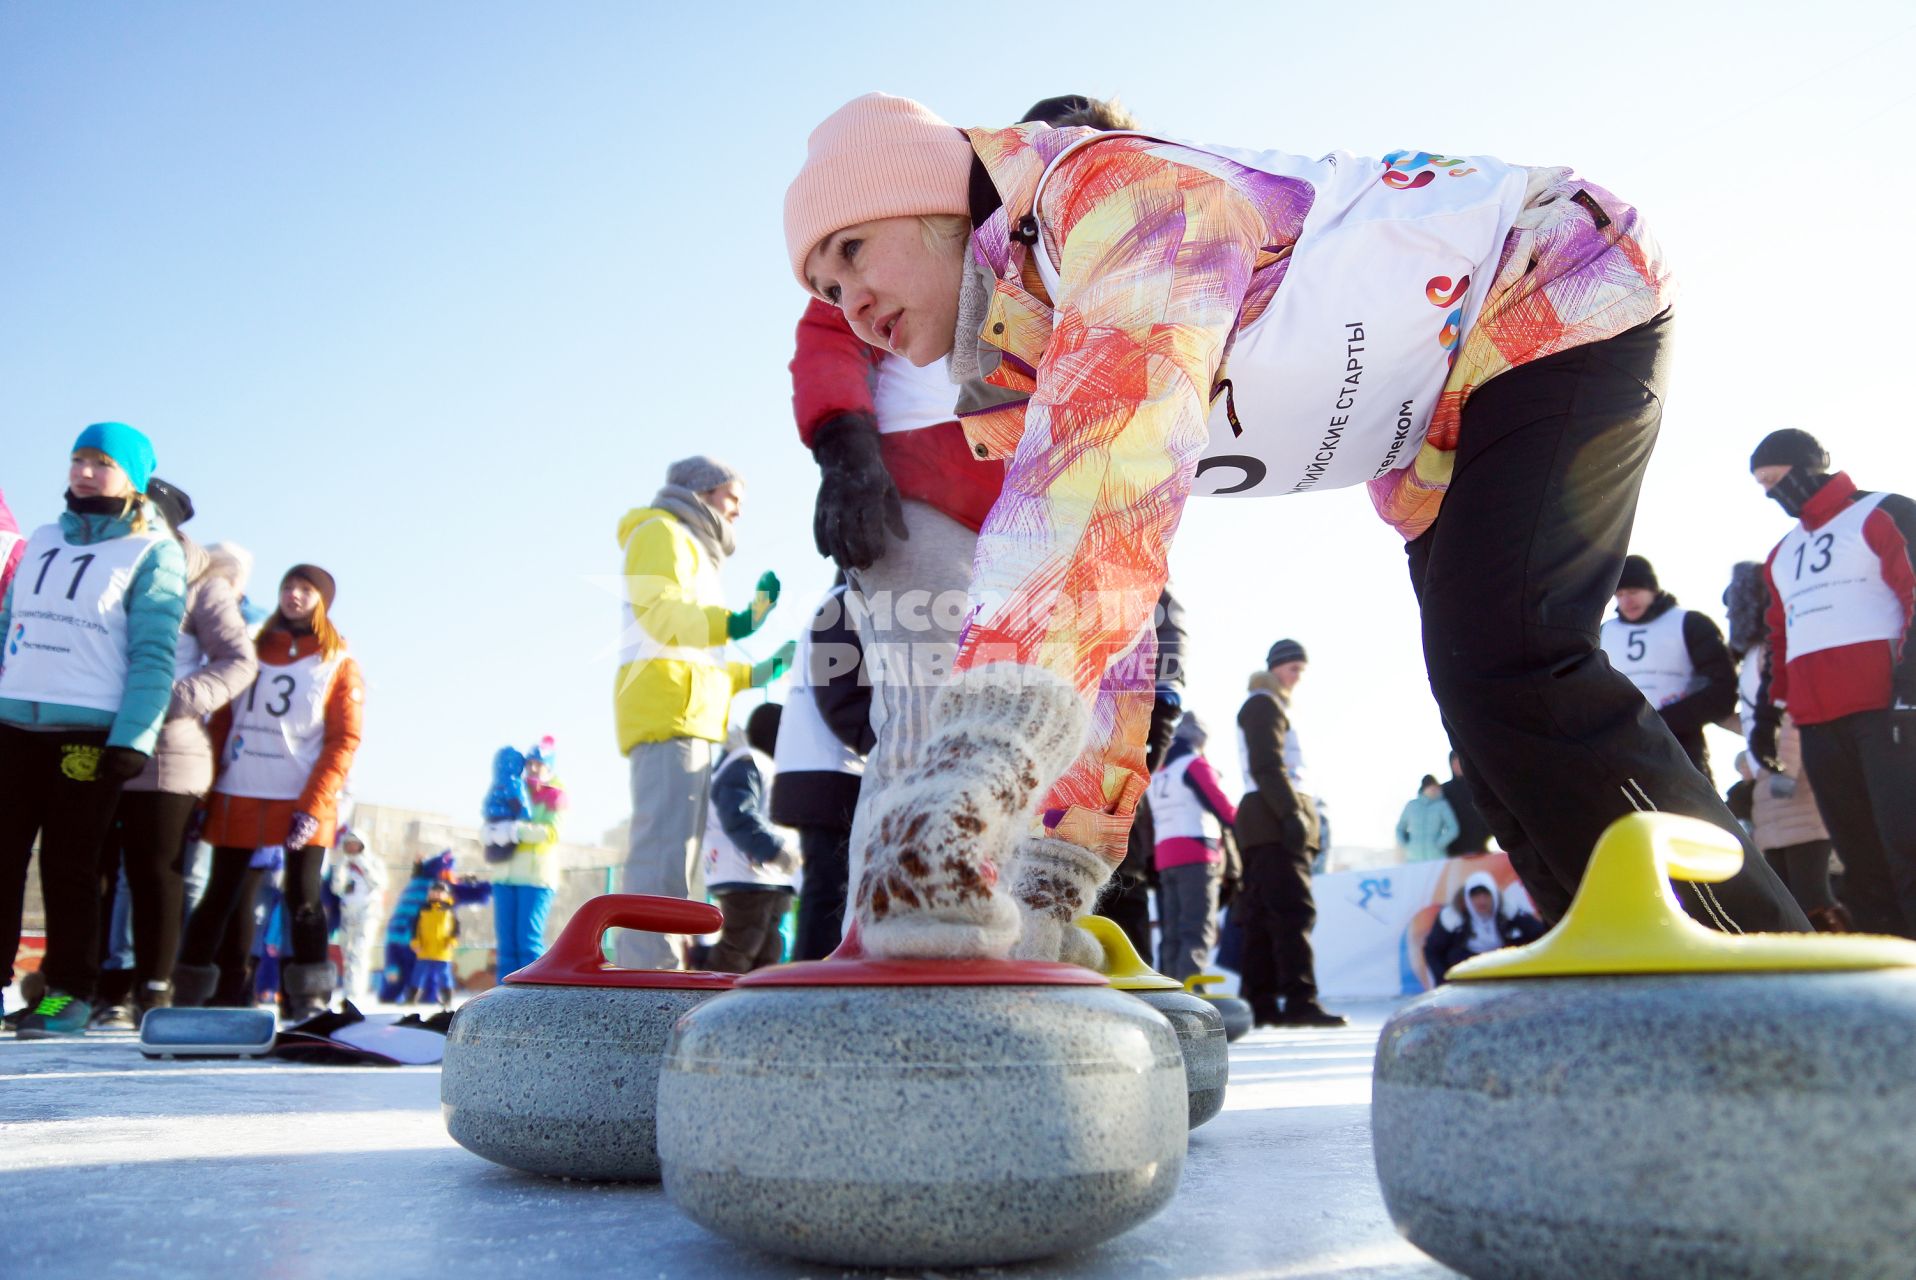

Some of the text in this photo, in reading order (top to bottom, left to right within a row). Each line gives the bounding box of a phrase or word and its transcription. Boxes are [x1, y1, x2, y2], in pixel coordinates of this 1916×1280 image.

[1336, 321, 1365, 410] СТАРТЫ
[33, 547, 97, 602] 11
[1793, 532, 1835, 581] 13
[1627, 629, 1648, 662] 5
[246, 669, 296, 718] 13
